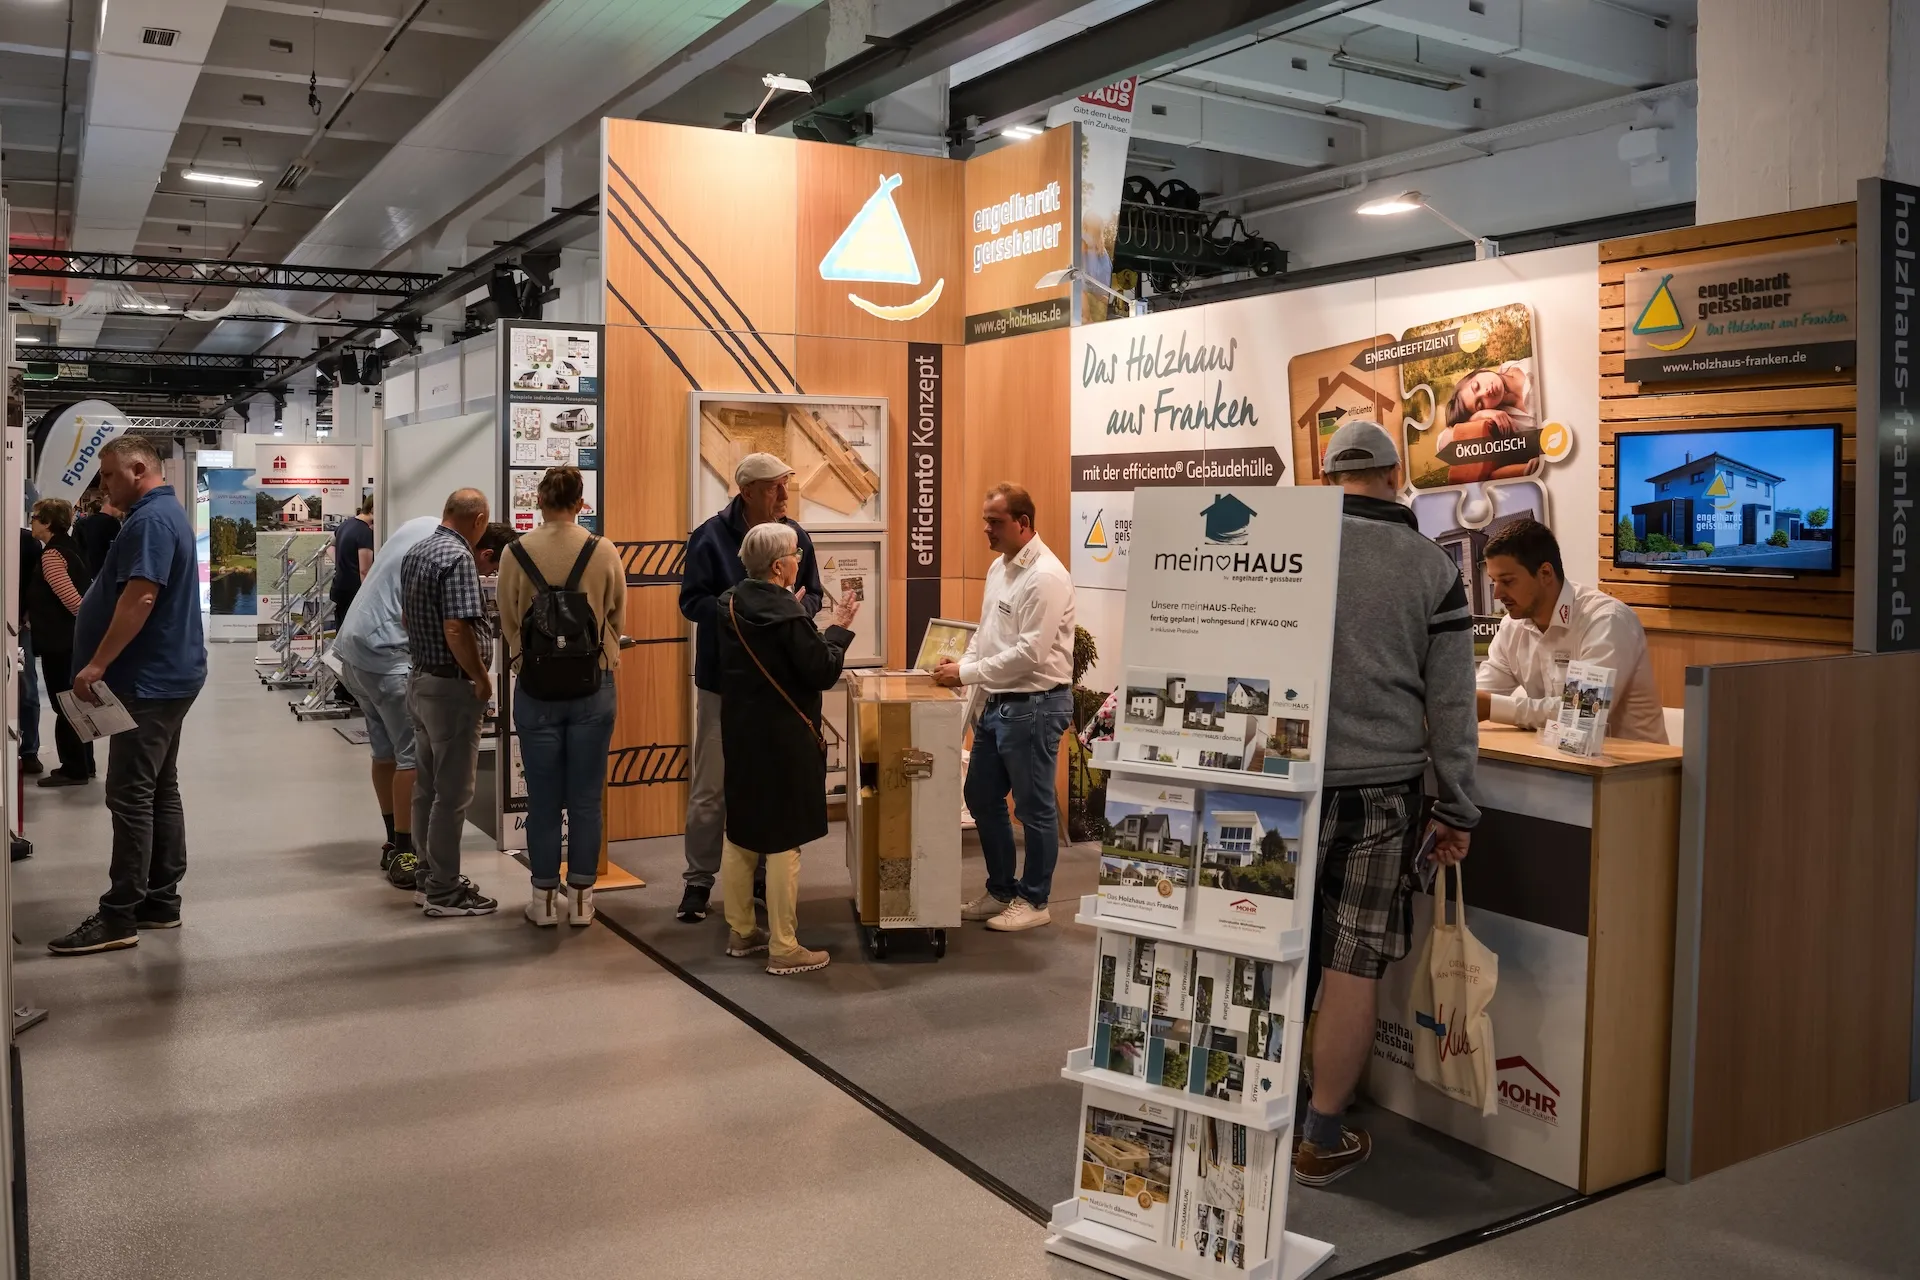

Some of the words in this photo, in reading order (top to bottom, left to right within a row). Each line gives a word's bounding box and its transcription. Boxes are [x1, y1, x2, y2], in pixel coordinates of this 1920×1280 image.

[1081, 87, 1130, 106] AUS
[1073, 105, 1090, 115] Gibt
[1090, 110, 1107, 119] dem
[1107, 113, 1130, 124] Leben
[1083, 119, 1095, 127] ein
[1096, 120, 1128, 134] Zuhause.
[973, 181, 1061, 234] engelhardt
[973, 222, 1062, 273] geissbauer
[1698, 272, 1792, 300] engelhardt
[1698, 293, 1792, 320] geissbauer
[974, 303, 1061, 335] www.eg-holzhaus.de
[1707, 322, 1724, 336] Das
[1727, 319, 1776, 334] Holzhaus
[1778, 316, 1798, 329] aus
[1801, 309, 1848, 326] Franken
[1082, 343, 1118, 388] Das
[1126, 330, 1238, 382] Holzhaus
[1365, 334, 1456, 365] ENERGIEEFFIZIENT
[1662, 351, 1808, 374] www.holzhaus-franken.de
[912, 355, 940, 447] Konzept
[1106, 404, 1146, 436] aus
[1154, 379, 1259, 432] Franken
[1890, 193, 1916, 641] holzhaus-franken.de
[61, 420, 115, 487] Fjorborg
[1455, 437, 1527, 458] ÖKOLOGISCH
[1082, 465, 1101, 481] mit
[1102, 463, 1121, 480] der
[1186, 457, 1274, 479] Gebäudehülle
[1696, 513, 1742, 523] engelhardt
[1232, 575, 1264, 583] engelhardt
[1269, 575, 1303, 584] geissbauer
[1151, 600, 1180, 610] Unsere
[1150, 614, 1169, 623] fertig
[1170, 615, 1196, 624] geplant
[1201, 617, 1246, 626] wohngesund
[1281, 619, 1299, 628] QNG
[1118, 894, 1145, 905] Holzhaus
[1156, 901, 1179, 911] Franken
[1236, 905, 1257, 913] MOHR
[1497, 1080, 1558, 1117] MOHR
[1510, 1100, 1521, 1109] für
[1520, 1105, 1531, 1114] die
[1113, 1205, 1138, 1218] dämmen
